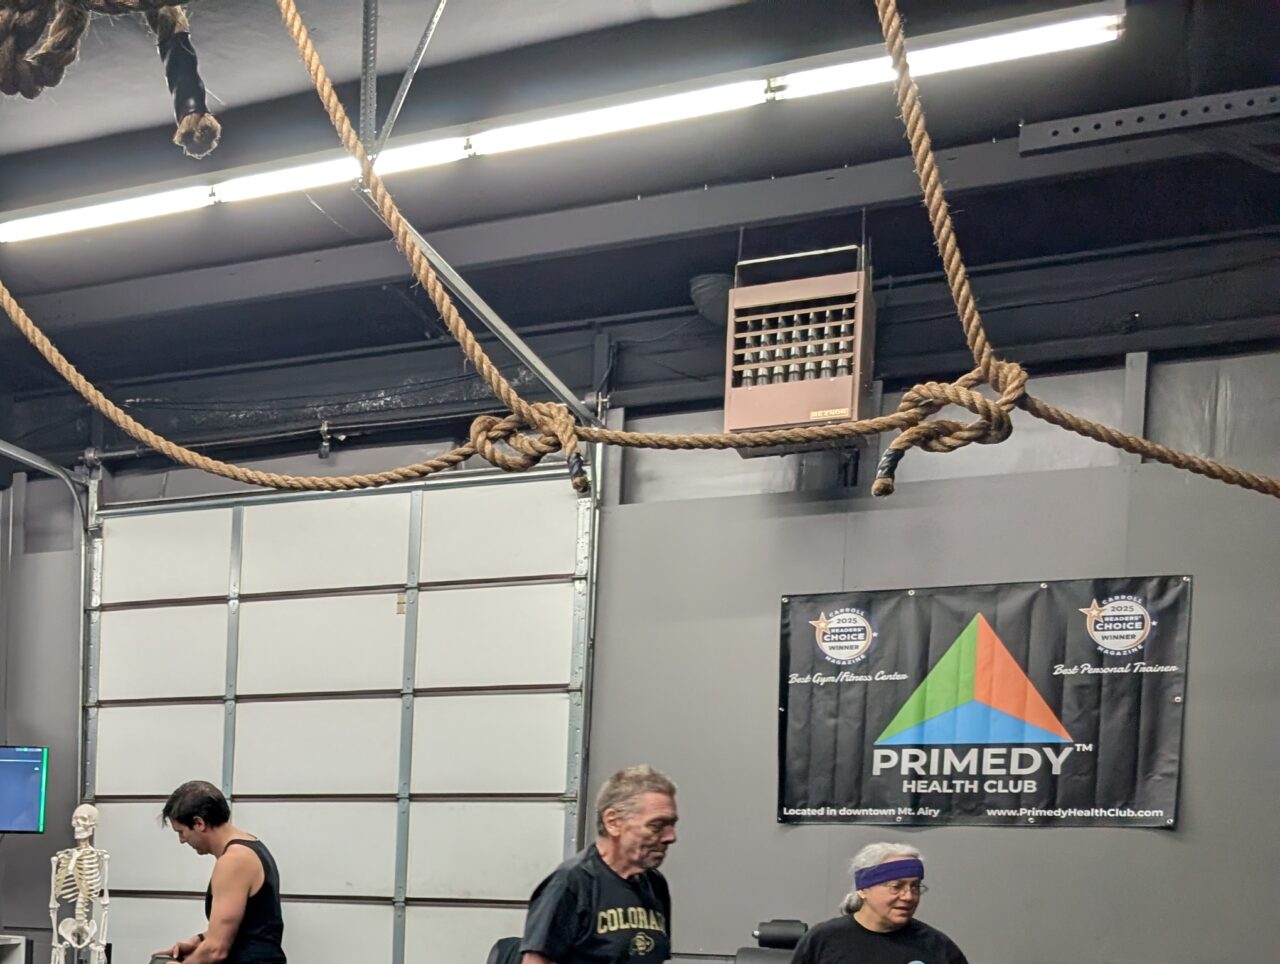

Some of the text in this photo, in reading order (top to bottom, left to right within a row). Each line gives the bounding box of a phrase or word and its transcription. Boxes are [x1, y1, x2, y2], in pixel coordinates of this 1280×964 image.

[1102, 595, 1142, 605] CARROLL
[829, 608, 865, 617] CARROLL
[1096, 621, 1143, 631] CHOICE
[823, 632, 865, 641] CHOICE
[1052, 662, 1179, 675] Best Personal Trainer
[788, 670, 910, 685] Best Gym/Fitness Center
[872, 747, 1074, 776] PRIMEDY
[902, 779, 1037, 793] HEALTH CLUB
[783, 806, 940, 818] Located in downtown Mt. Airy
[986, 807, 1164, 819] www.PrimedyHealthClub.com
